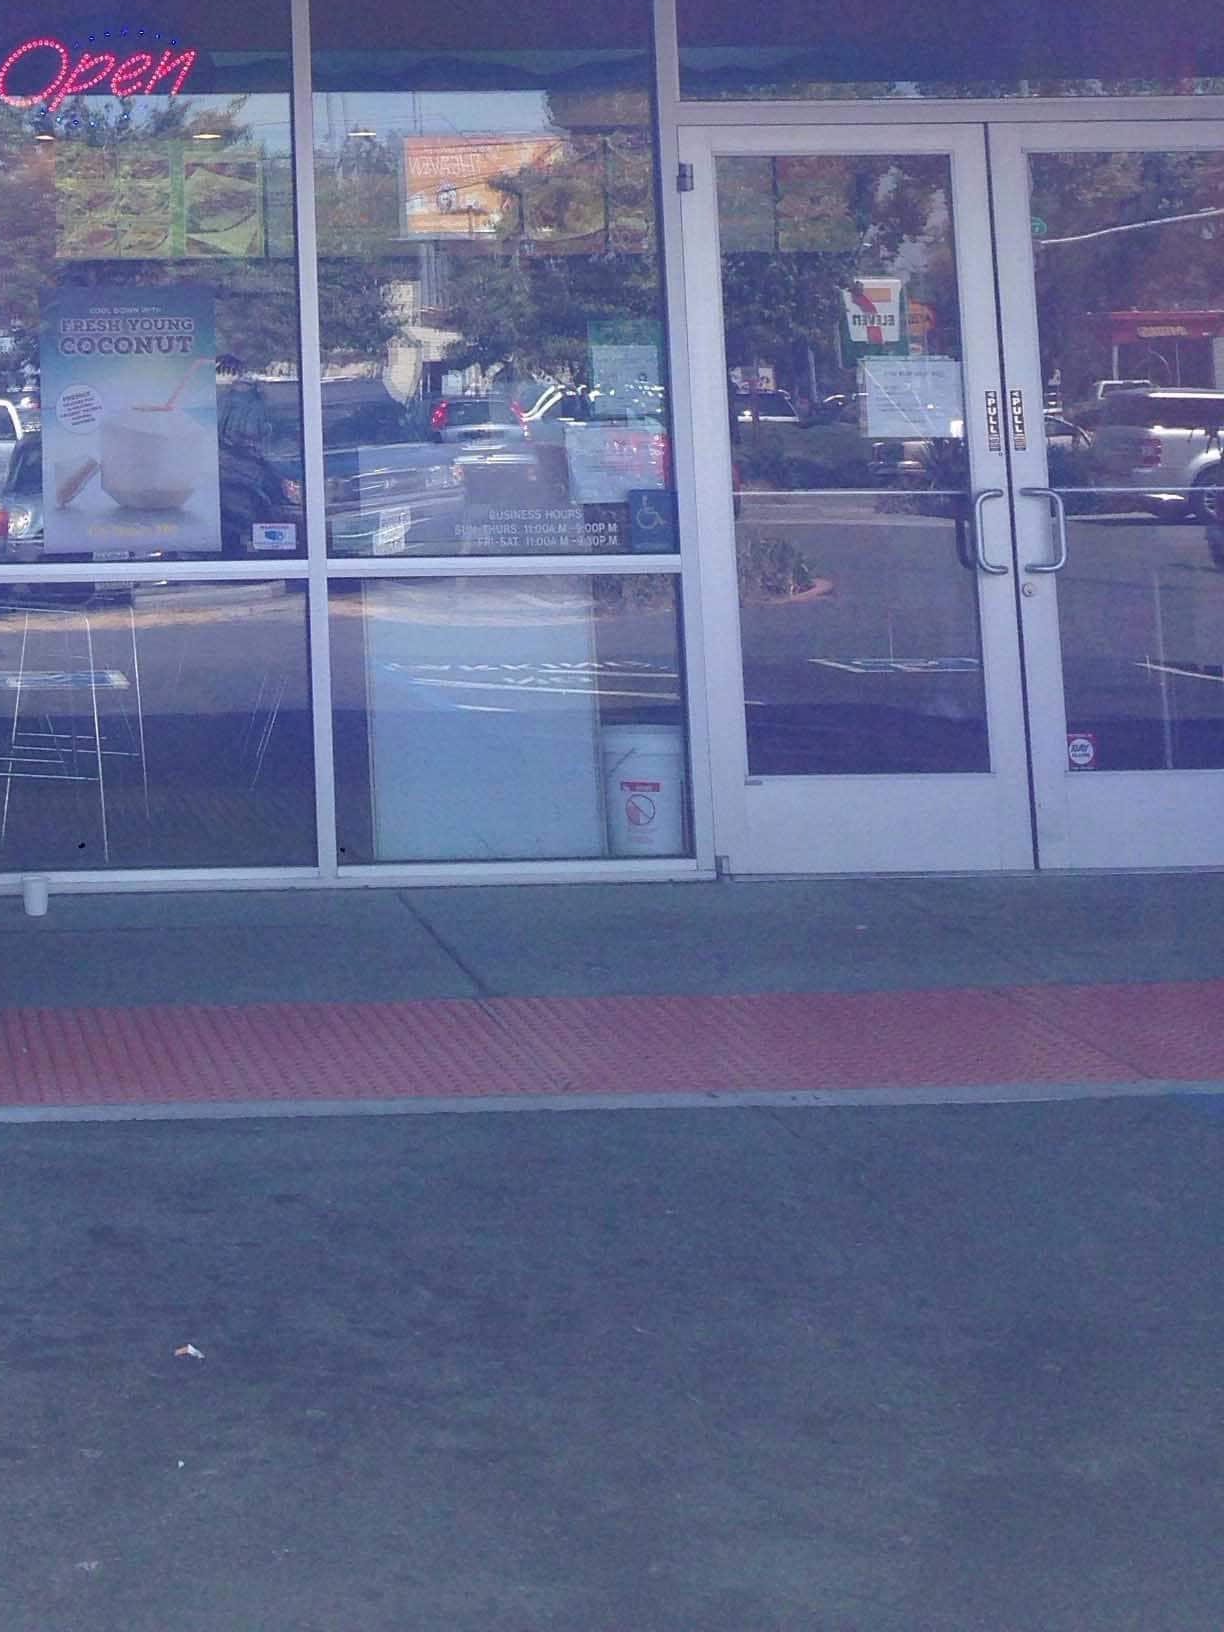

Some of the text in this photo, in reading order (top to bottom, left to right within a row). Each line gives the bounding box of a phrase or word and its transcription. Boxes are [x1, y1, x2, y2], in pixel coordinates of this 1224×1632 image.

[61, 318, 194, 333] FRESH YOUNG
[59, 335, 194, 355] COCONUT
[987, 398, 998, 434] PULL
[1012, 397, 1023, 433] PULL
[488, 511, 542, 520] BUSINESS
